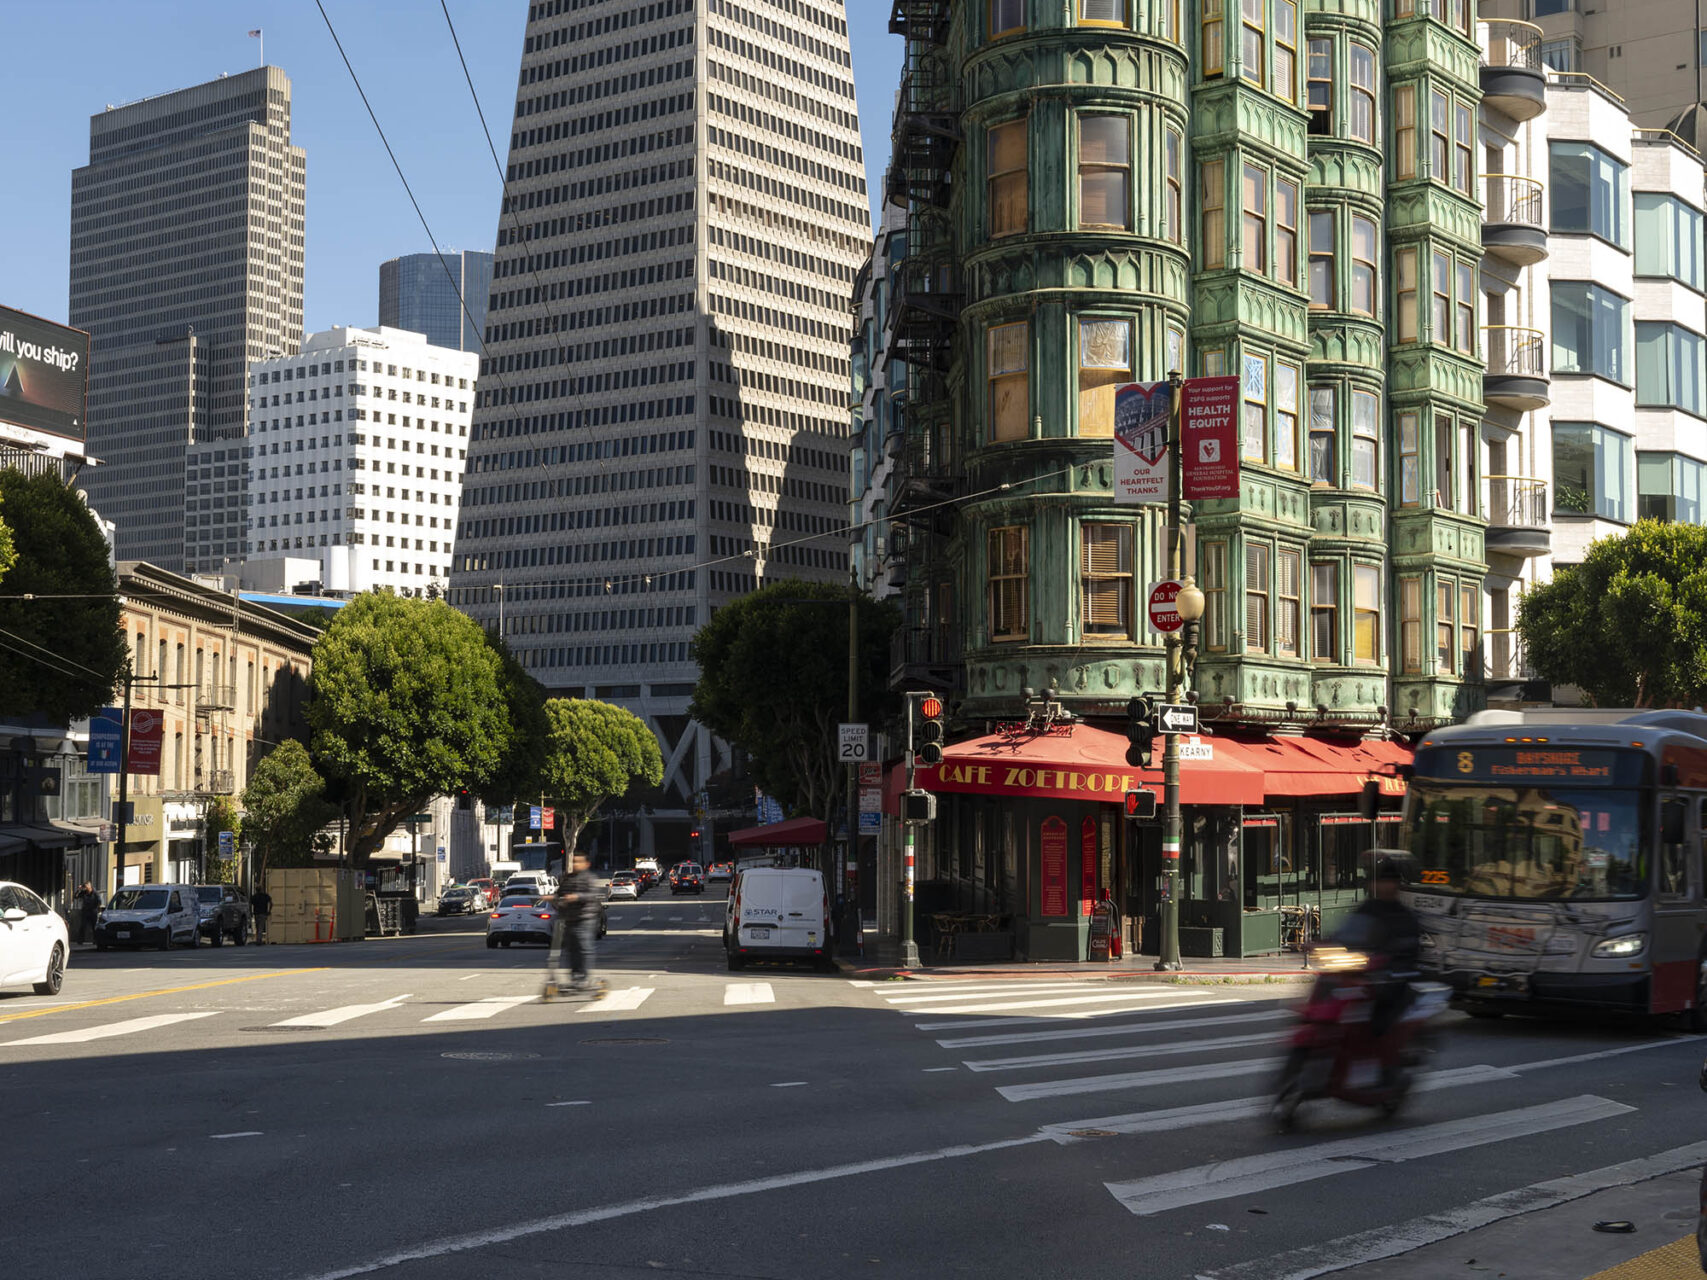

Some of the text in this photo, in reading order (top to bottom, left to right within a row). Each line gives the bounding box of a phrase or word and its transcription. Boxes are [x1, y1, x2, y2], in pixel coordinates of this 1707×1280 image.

[0, 331, 79, 372] ill you ship?
[1188, 404, 1231, 416] HEALTH
[1189, 417, 1229, 428] EQUITY
[1133, 468, 1151, 476] OUR
[1120, 477, 1164, 486] HEARTFELT
[1127, 486, 1159, 495] THANKS
[1154, 593, 1165, 601] DO
[1157, 613, 1181, 623] ENTER
[1170, 714, 1181, 723] ONE
[842, 743, 865, 758] 20
[1180, 746, 1210, 757] KEARNY
[1457, 751, 1474, 773] 8
[939, 764, 992, 784] CAFE
[1420, 870, 1450, 884] 225
